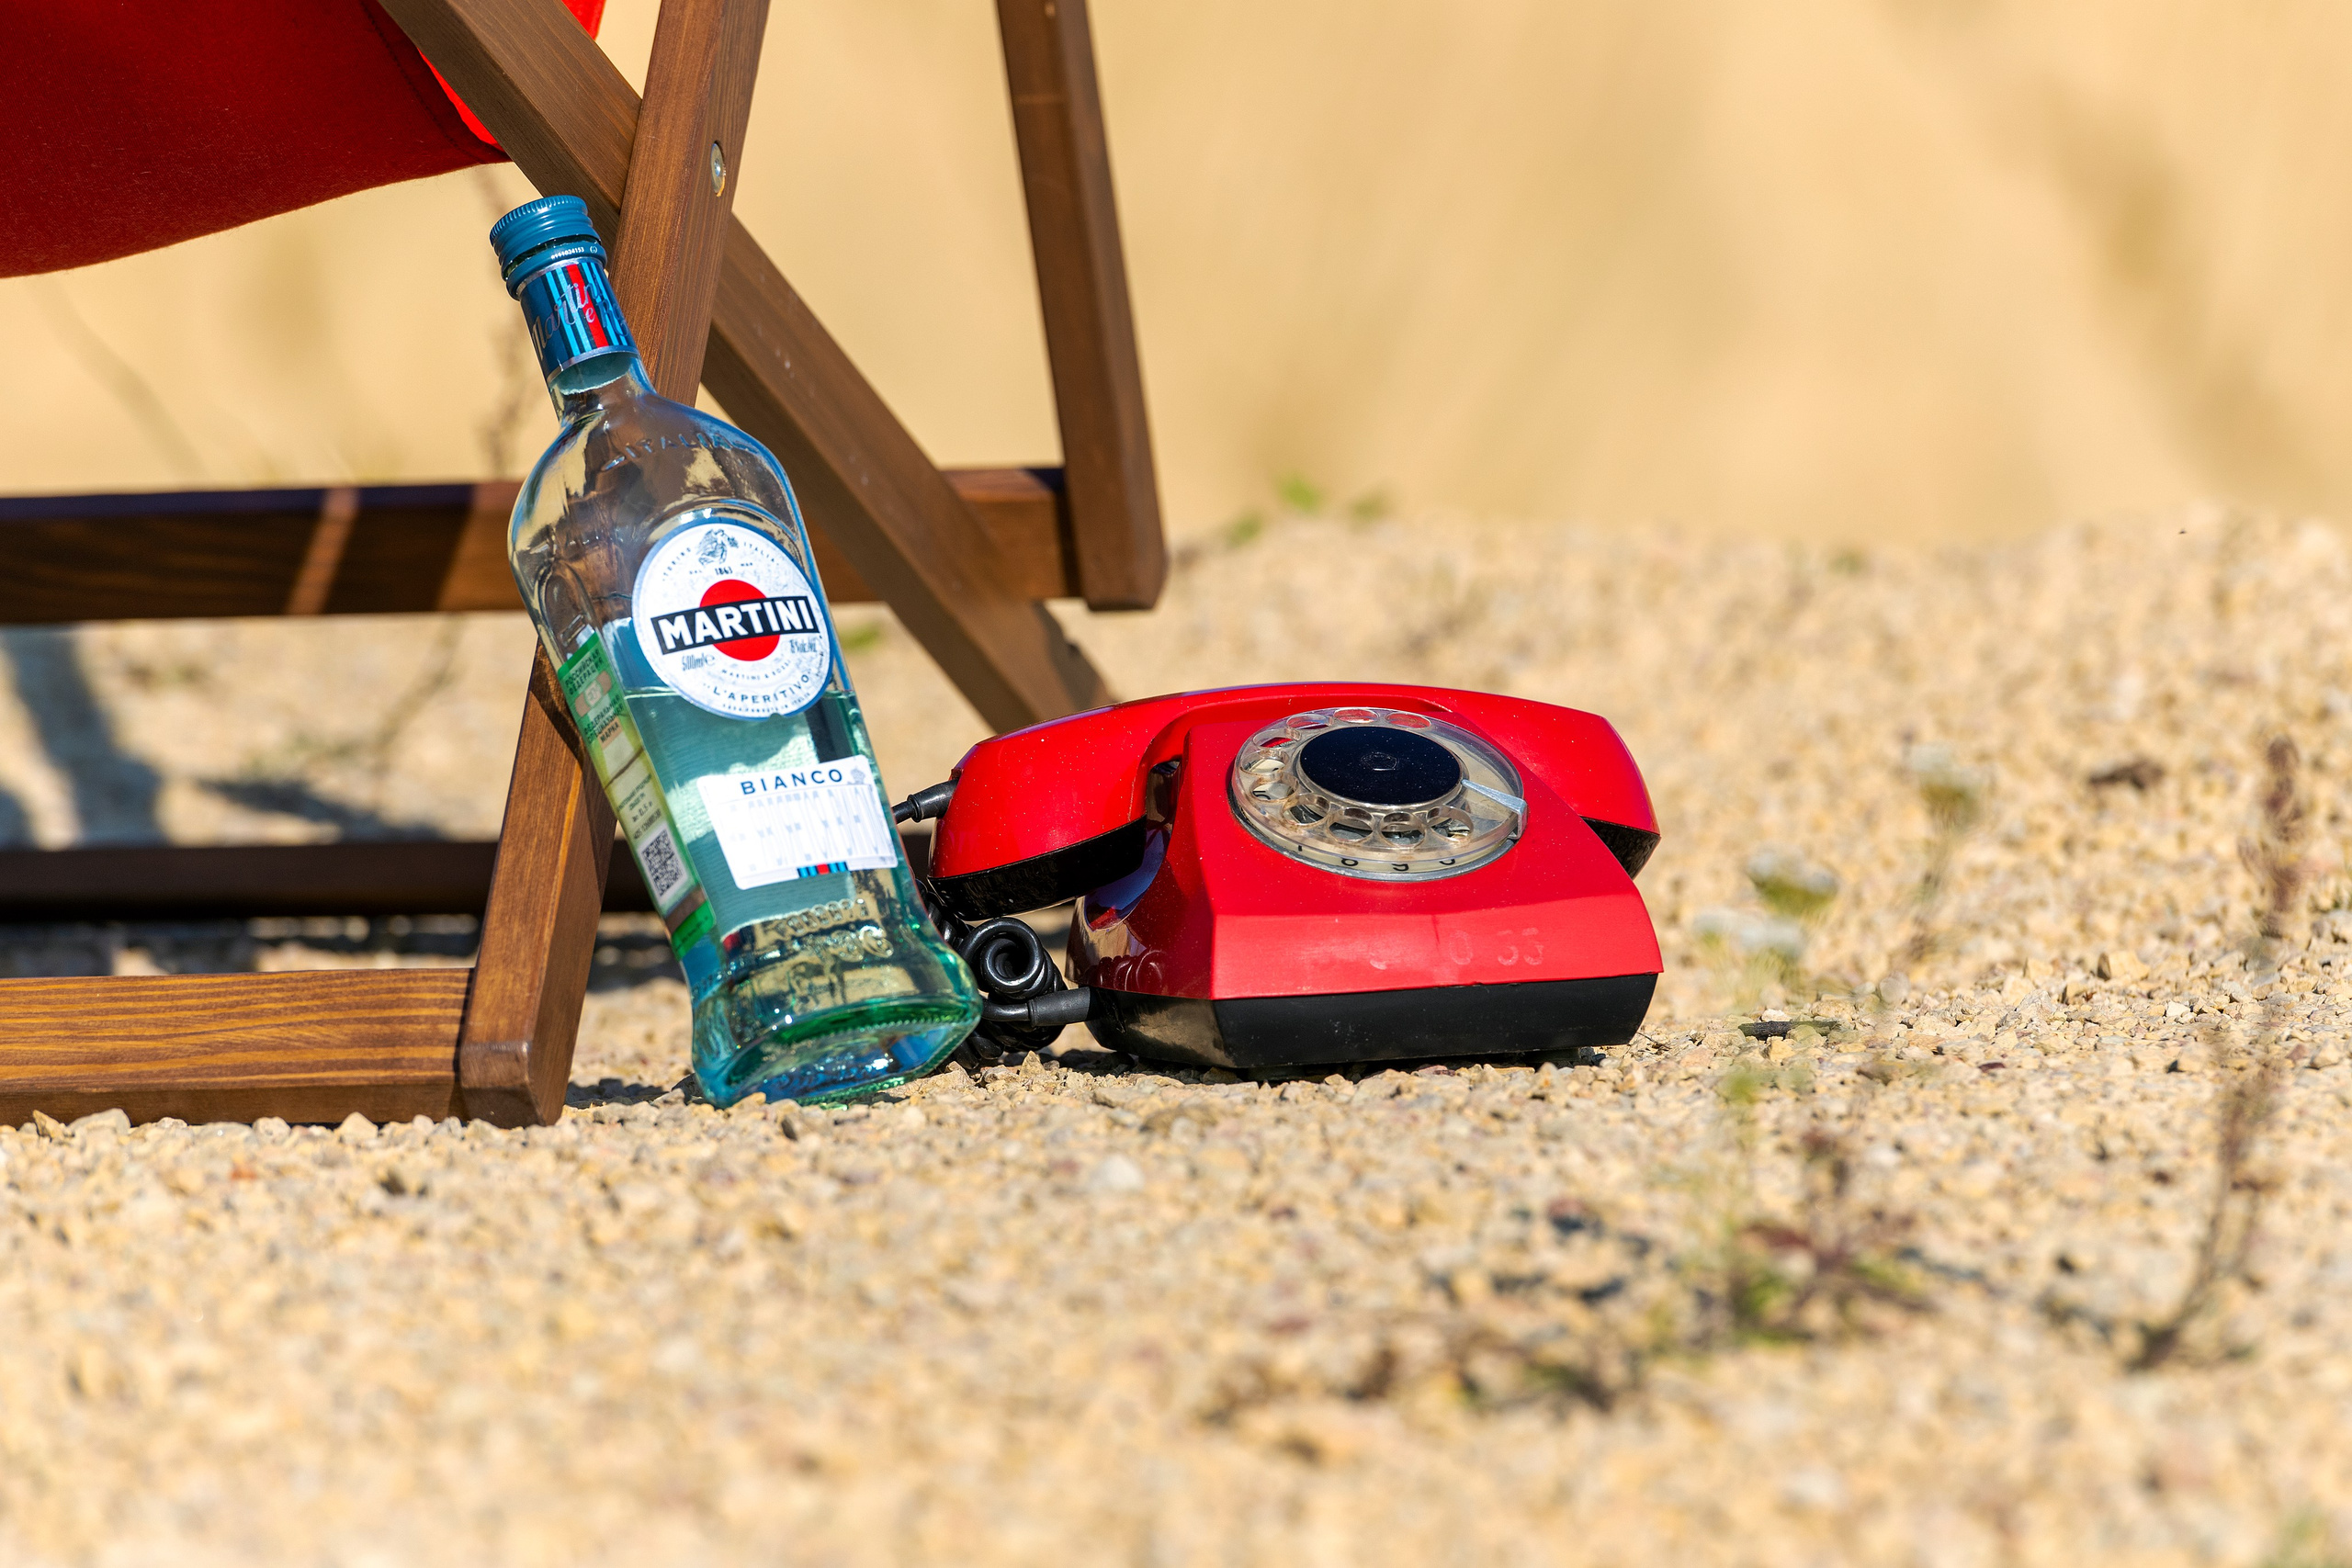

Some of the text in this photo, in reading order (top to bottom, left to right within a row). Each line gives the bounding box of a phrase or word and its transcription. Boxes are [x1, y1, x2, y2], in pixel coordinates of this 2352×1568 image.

[743, 541, 777, 563] ITALIA
[657, 599, 814, 650] MARTINI
[565, 649, 600, 687] РОССИЙСКАЯ
[569, 657, 604, 695] ФЕДЕРАЦИЯ
[721, 669, 762, 681] MARTINI
[713, 673, 810, 705] L'APERITIVO
[583, 694, 620, 736] ФЕДЕРАЛЬНАЯ
[600, 722, 620, 743] МАРКА
[741, 769, 842, 795] BIANCO
